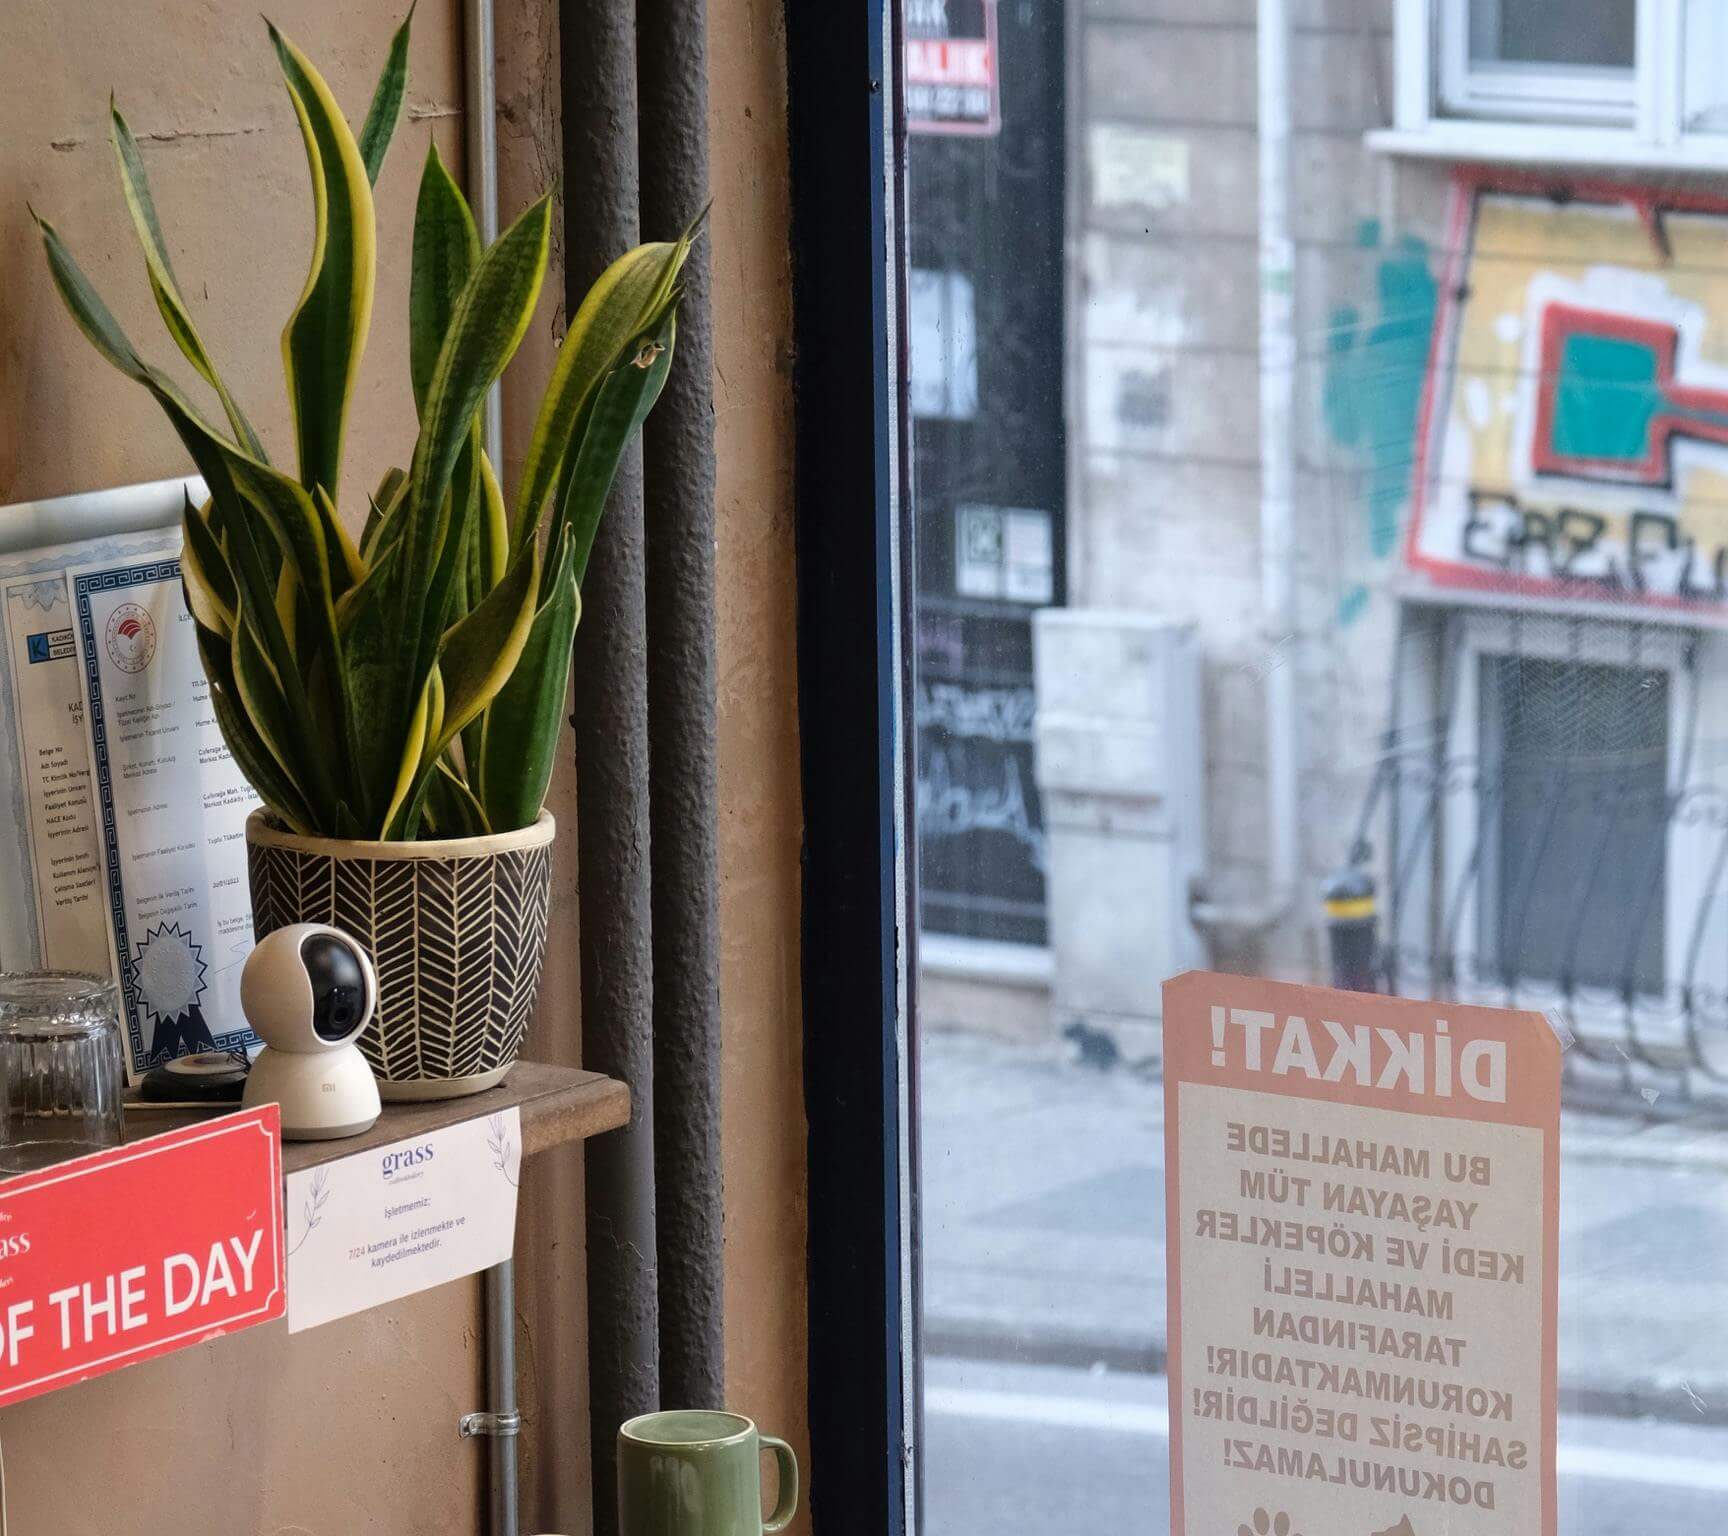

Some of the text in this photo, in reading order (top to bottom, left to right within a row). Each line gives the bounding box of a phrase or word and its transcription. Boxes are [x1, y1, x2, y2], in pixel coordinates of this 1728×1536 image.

[382, 1143, 434, 1179] grass
[348, 1246, 366, 1260] 7/24
[367, 1236, 397, 1254] kamera
[411, 1219, 454, 1241] izlenmekte
[455, 1216, 466, 1225] ve
[0, 1228, 264, 1367] F THE DAY
